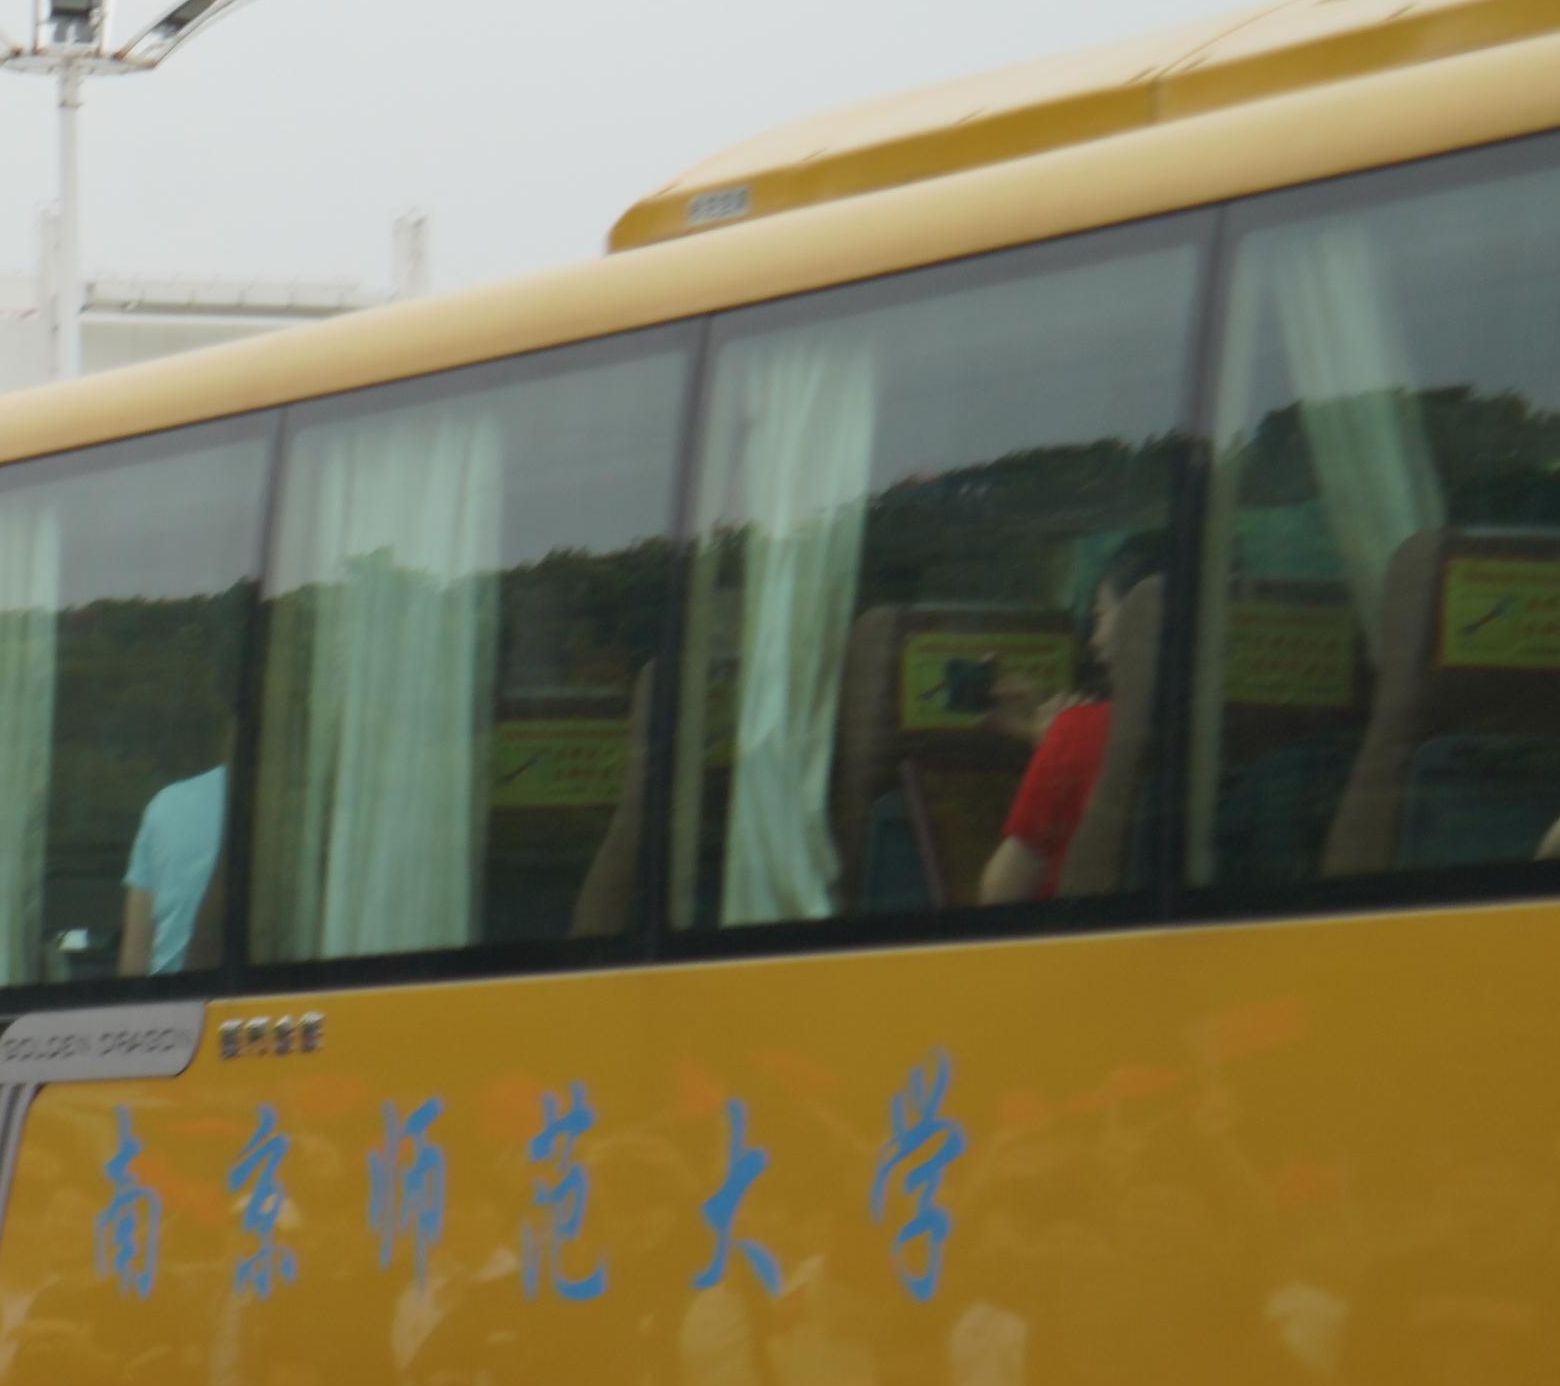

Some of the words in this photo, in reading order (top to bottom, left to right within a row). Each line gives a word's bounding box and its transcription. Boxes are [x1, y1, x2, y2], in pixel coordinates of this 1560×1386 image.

[93, 1047, 967, 1302] 南京师范大学
